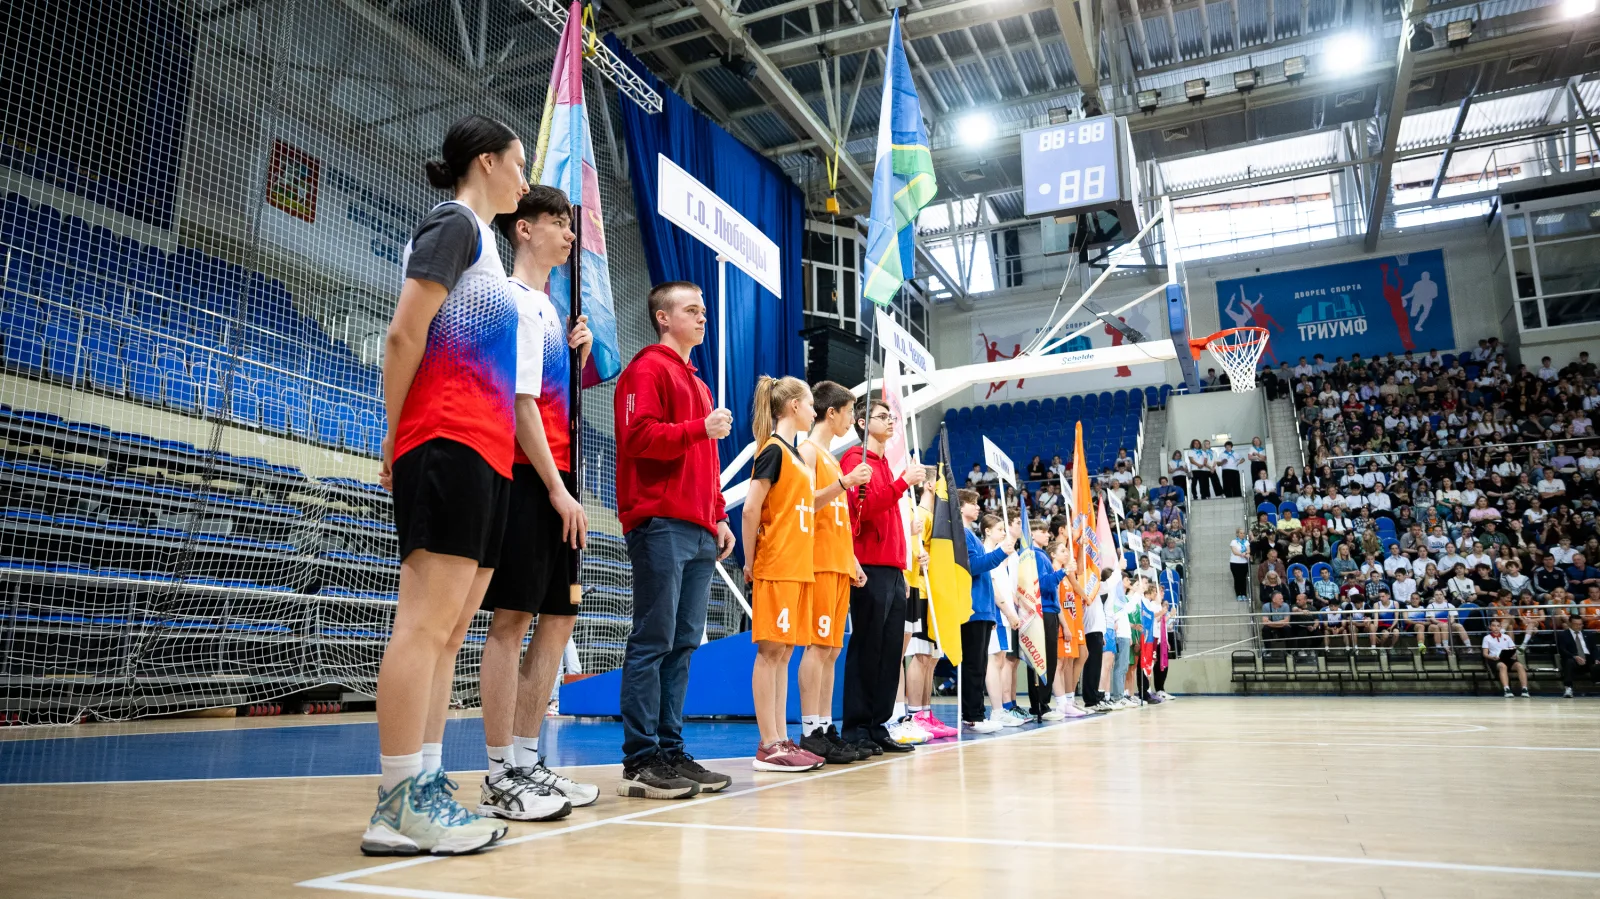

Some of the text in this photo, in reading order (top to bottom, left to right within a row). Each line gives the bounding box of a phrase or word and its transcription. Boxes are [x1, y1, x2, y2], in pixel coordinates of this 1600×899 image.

[713, 206, 767, 273] Люберцы
[1294, 283, 1362, 299] ДВОРЕЦ СПОРТА
[1297, 317, 1368, 342] ТРИУМФ
[1061, 353, 1095, 365] Schelde
[777, 607, 791, 633] 4
[817, 614, 832, 638] 9
[1020, 633, 1045, 670] «ВОСХОД»
